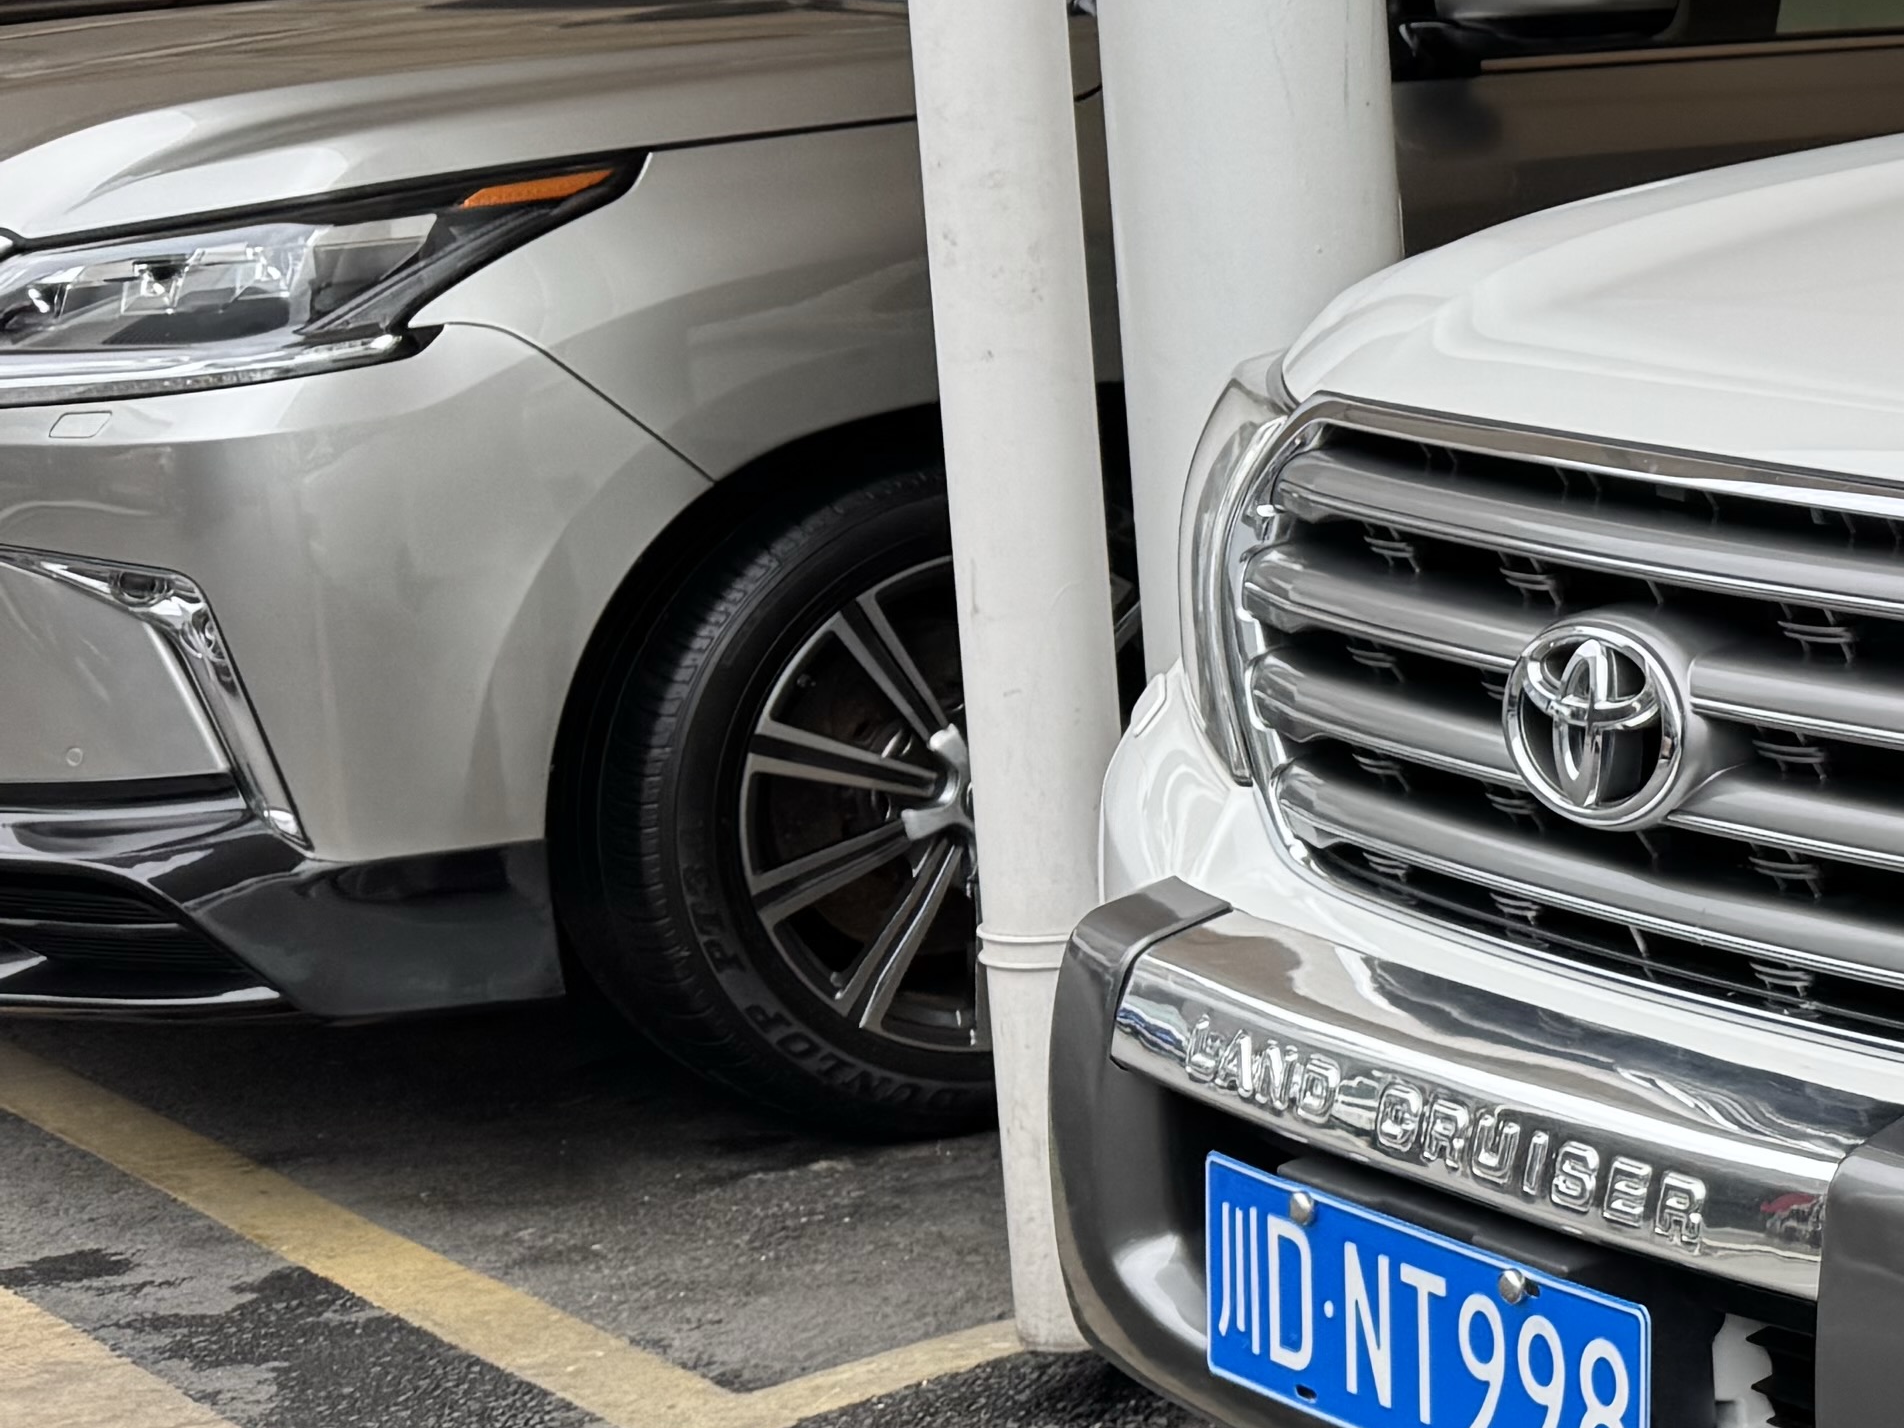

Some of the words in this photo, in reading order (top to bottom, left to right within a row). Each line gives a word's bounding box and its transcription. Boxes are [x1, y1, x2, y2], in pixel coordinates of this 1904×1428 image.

[743, 1003, 963, 1110] DUNLOP
[1185, 1013, 1341, 1124] LAND
[1375, 1082, 1707, 1244] CRUISER
